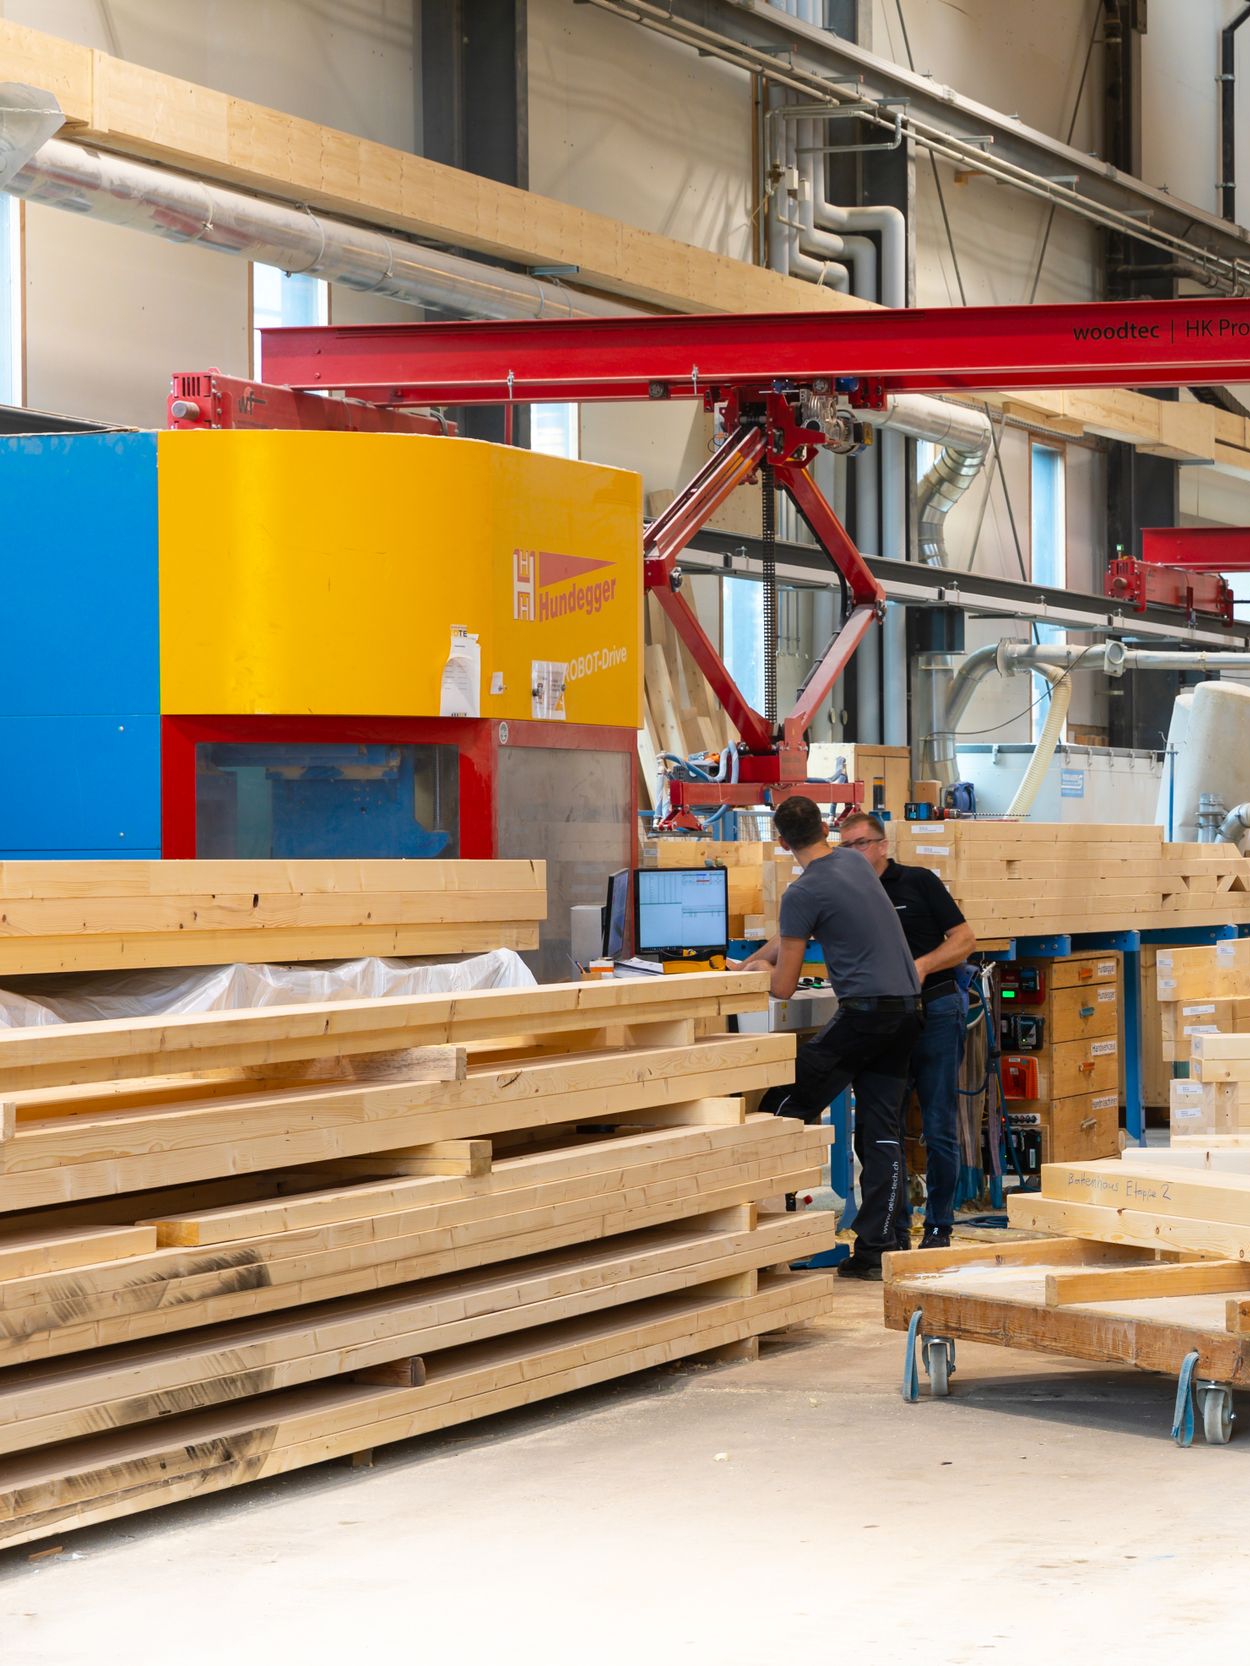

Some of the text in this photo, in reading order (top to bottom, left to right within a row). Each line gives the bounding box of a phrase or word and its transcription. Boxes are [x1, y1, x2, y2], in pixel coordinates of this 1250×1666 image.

[1073, 320, 1160, 341] woodtec
[1186, 319, 1214, 338] HK
[1219, 319, 1250, 337] Pro
[539, 577, 617, 622] Hundegger
[883, 1161, 899, 1235] www.oeko-tech.ch
[1160, 1183, 1172, 1201] 2
